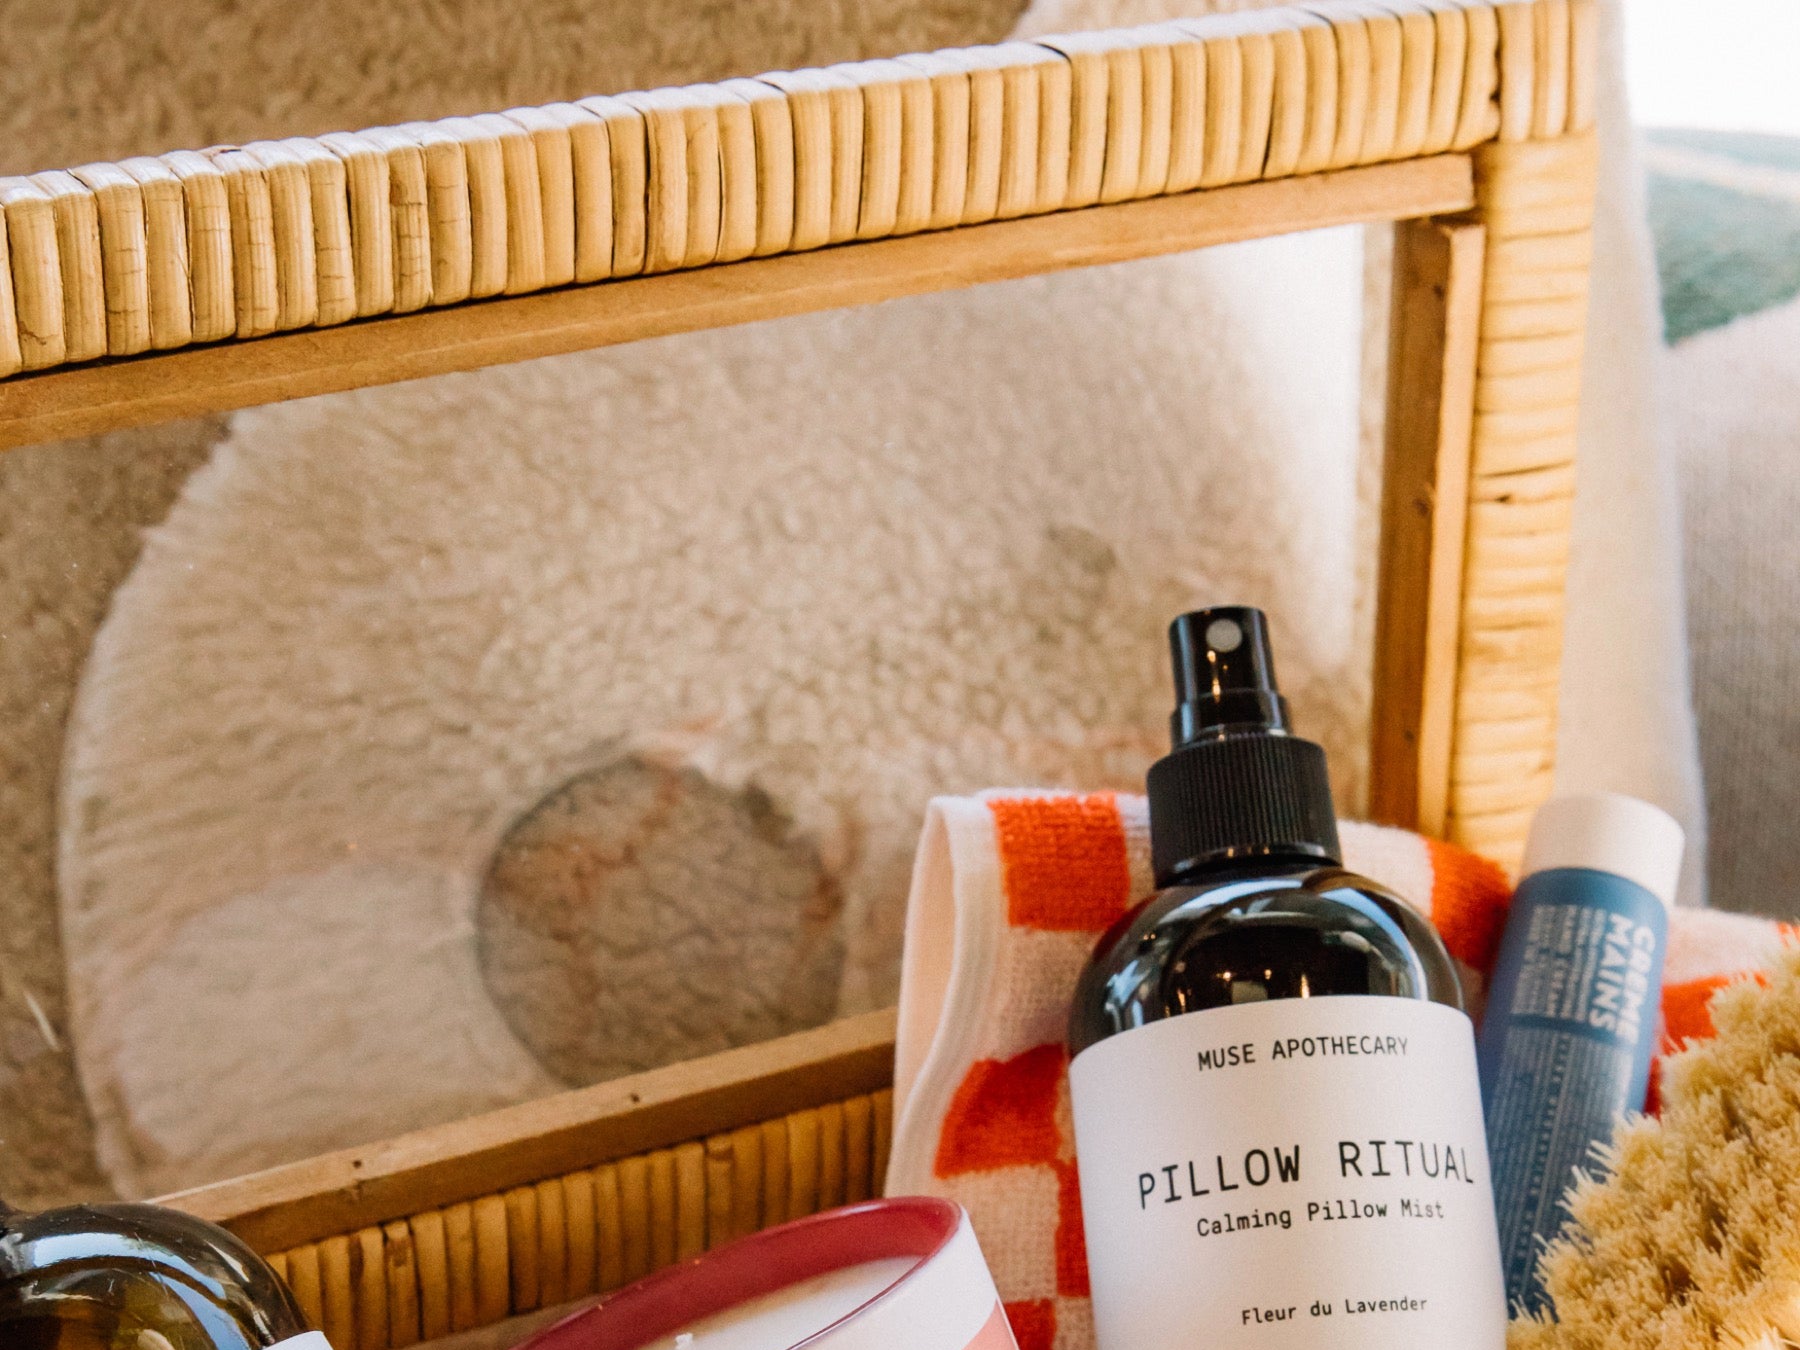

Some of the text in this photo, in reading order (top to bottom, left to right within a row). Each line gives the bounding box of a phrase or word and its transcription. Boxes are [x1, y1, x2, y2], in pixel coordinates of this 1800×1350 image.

[1589, 913, 1633, 1032] MAINS
[1198, 1036, 1408, 1071] MUSE APOTHECARY
[1138, 1140, 1474, 1210] PILLOW RITUAL
[1197, 1199, 1444, 1237] Calming Pillow Mist
[1242, 1296, 1427, 1325] Fleur du Lavender
